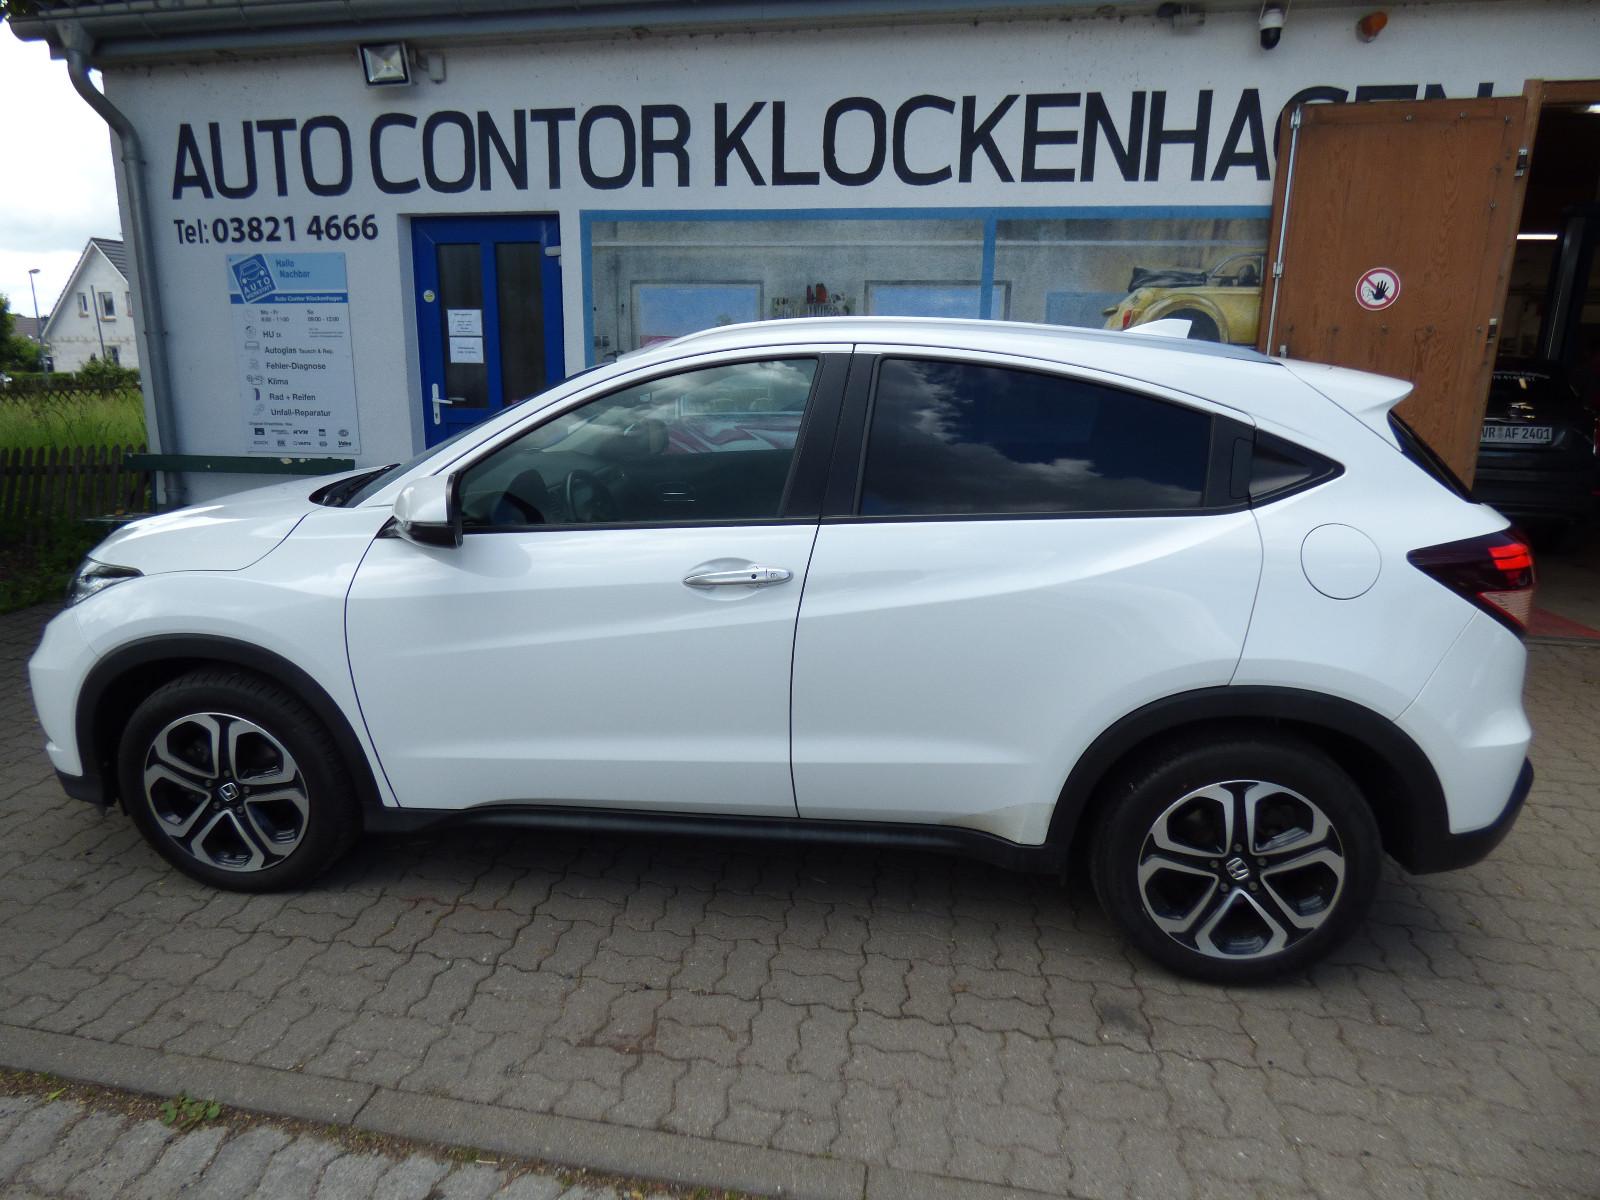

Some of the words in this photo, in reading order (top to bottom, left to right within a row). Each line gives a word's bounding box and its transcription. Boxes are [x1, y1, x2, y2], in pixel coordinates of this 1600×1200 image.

[172, 115, 353, 200] AUTO
[369, 104, 691, 194] CONTOR
[714, 82, 1494, 188] KLOCKENHA
[173, 218, 210, 245] Tel:
[212, 215, 296, 244] 03821
[307, 213, 379, 242] 4666
[244, 276, 271, 294] AUTO
[264, 346, 297, 355] Autoglas
[266, 361, 327, 371] Fehler-Diagnose
[267, 377, 289, 385] Klima
[269, 392, 284, 401] Rad
[292, 393, 316, 401] Reifen
[271, 408, 331, 418] Unfall-Reparatur
[1504, 427, 1519, 439] AF
[1521, 427, 1550, 440] 2401
